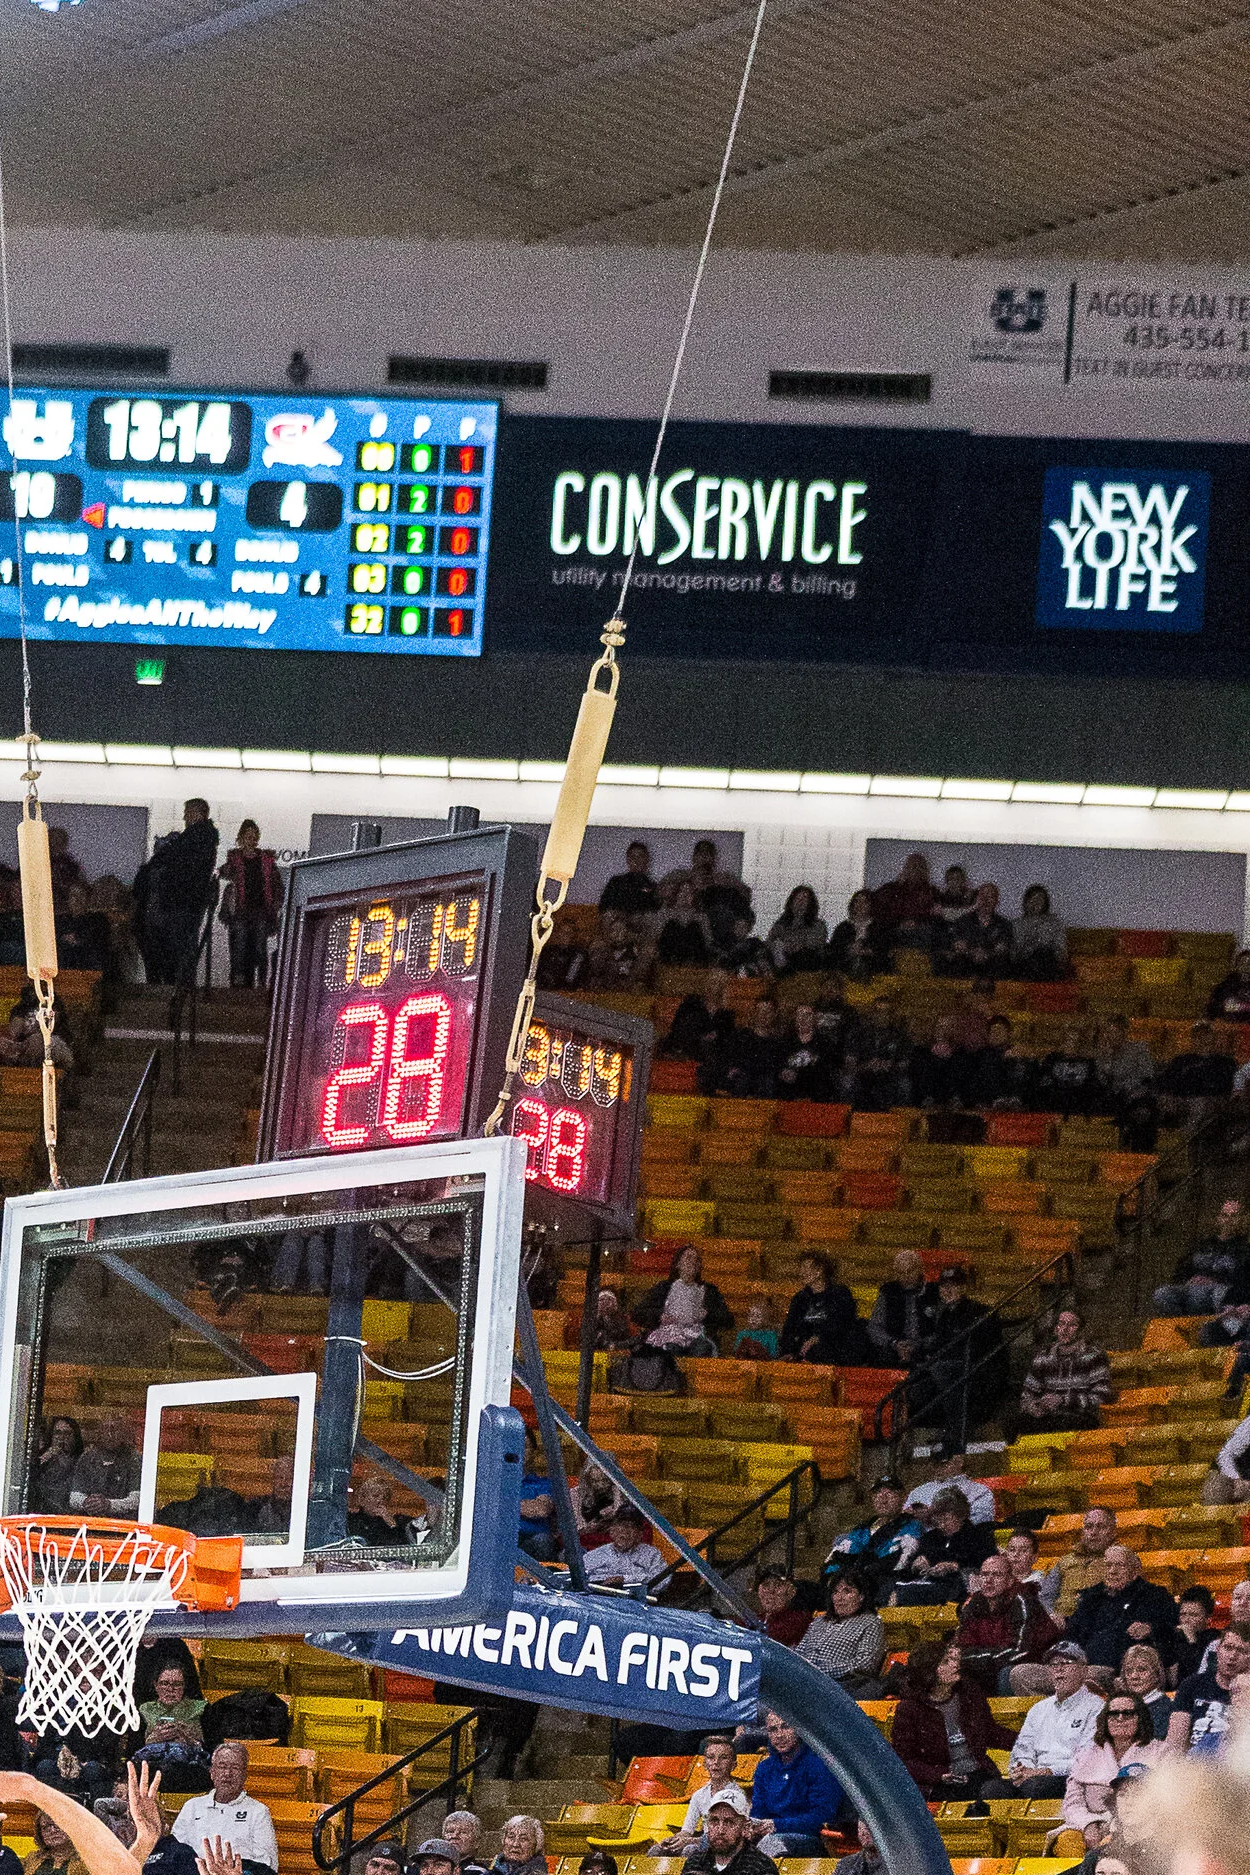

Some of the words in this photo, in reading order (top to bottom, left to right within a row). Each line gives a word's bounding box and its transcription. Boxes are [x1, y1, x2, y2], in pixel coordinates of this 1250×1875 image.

[104, 400, 232, 464] 13:14
[459, 446, 474, 474] 1
[280, 481, 309, 528] 4
[409, 484, 429, 514] 2
[453, 485, 473, 514] 0
[550, 468, 868, 565] CONSERVICE
[1070, 481, 1190, 531] NEW
[406, 525, 426, 554] 2
[451, 526, 470, 555] 0
[1050, 519, 1198, 575] YORK
[448, 567, 468, 596] 0
[551, 568, 607, 595] utility
[613, 569, 763, 596] management
[790, 571, 857, 600] billing
[1065, 566, 1181, 613] LIFE
[350, 603, 384, 634] 32
[448, 608, 463, 637] 1
[344, 898, 480, 989] 13:14
[322, 993, 451, 1148] 28
[521, 1024, 622, 1098] 3:14
[513, 1097, 588, 1192] 28
[617, 1632, 753, 1702] FIRST
